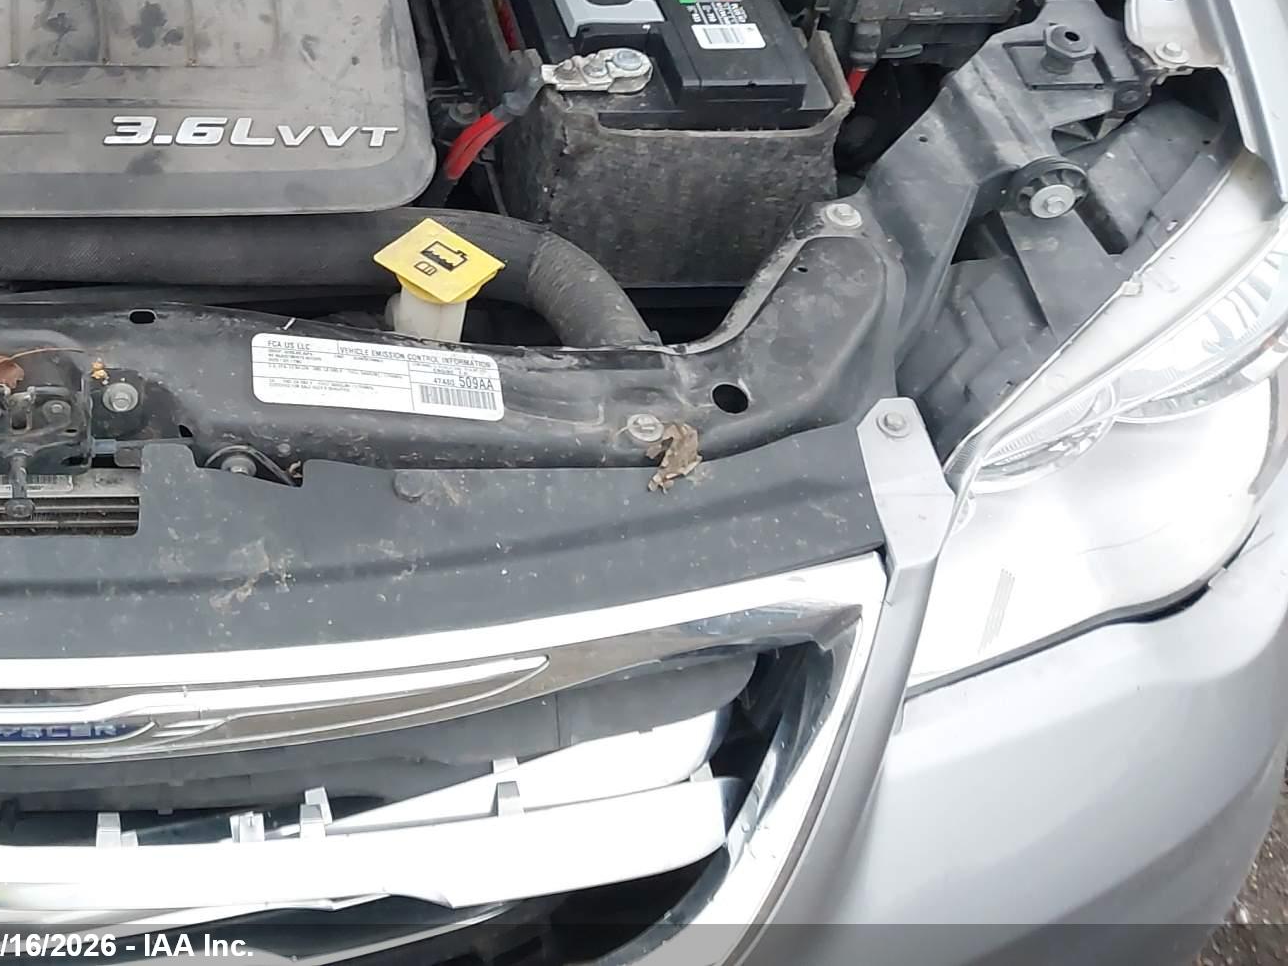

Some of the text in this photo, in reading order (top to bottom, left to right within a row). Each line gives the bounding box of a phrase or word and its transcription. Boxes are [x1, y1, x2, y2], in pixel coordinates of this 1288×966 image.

[267, 340, 282, 348] FCA
[284, 341, 295, 349] US
[340, 346, 369, 356] VEHICLE
[371, 349, 405, 360] EMISSION
[407, 353, 439, 364] CONTROL
[441, 357, 491, 369] INFORMATION
